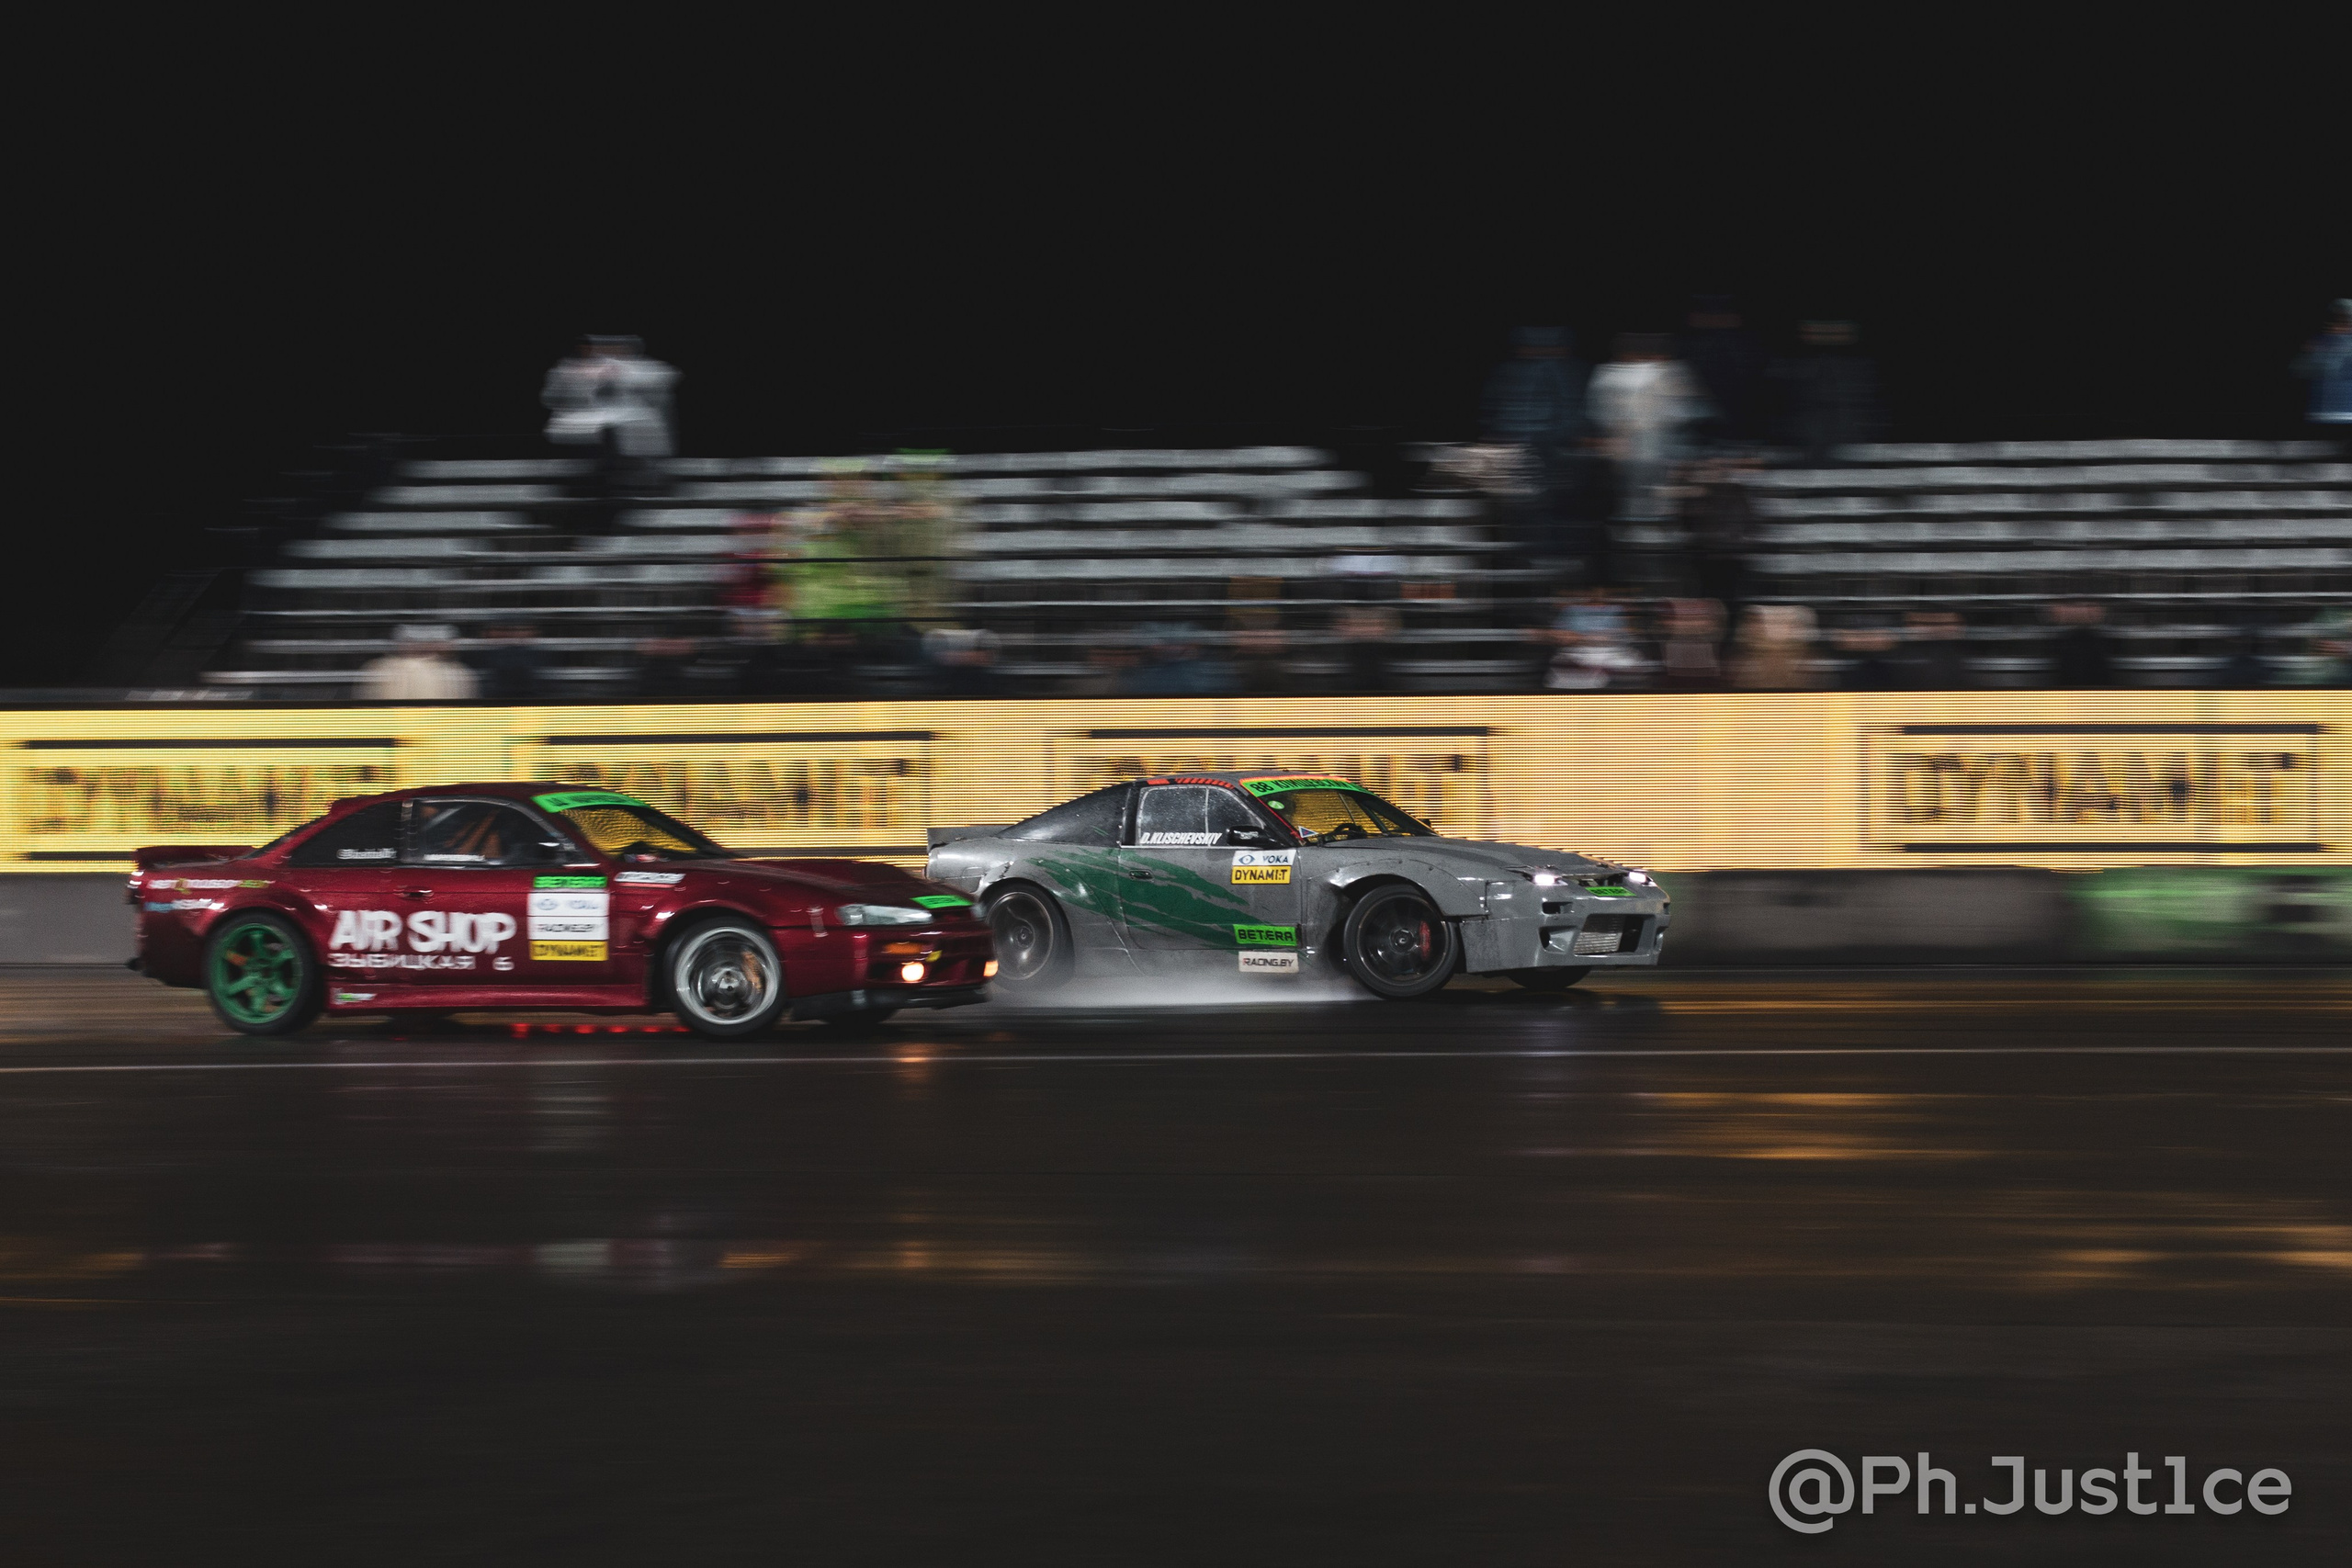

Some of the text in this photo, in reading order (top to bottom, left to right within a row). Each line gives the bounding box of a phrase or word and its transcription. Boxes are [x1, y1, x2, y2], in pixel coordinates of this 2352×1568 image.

[1250, 781, 1275, 793] 88
[1139, 832, 1223, 845] D.KLISCHEVSKIY
[1262, 855, 1289, 864] VOKA
[328, 909, 517, 954] AIR SHOP
[492, 956, 515, 972] 6
